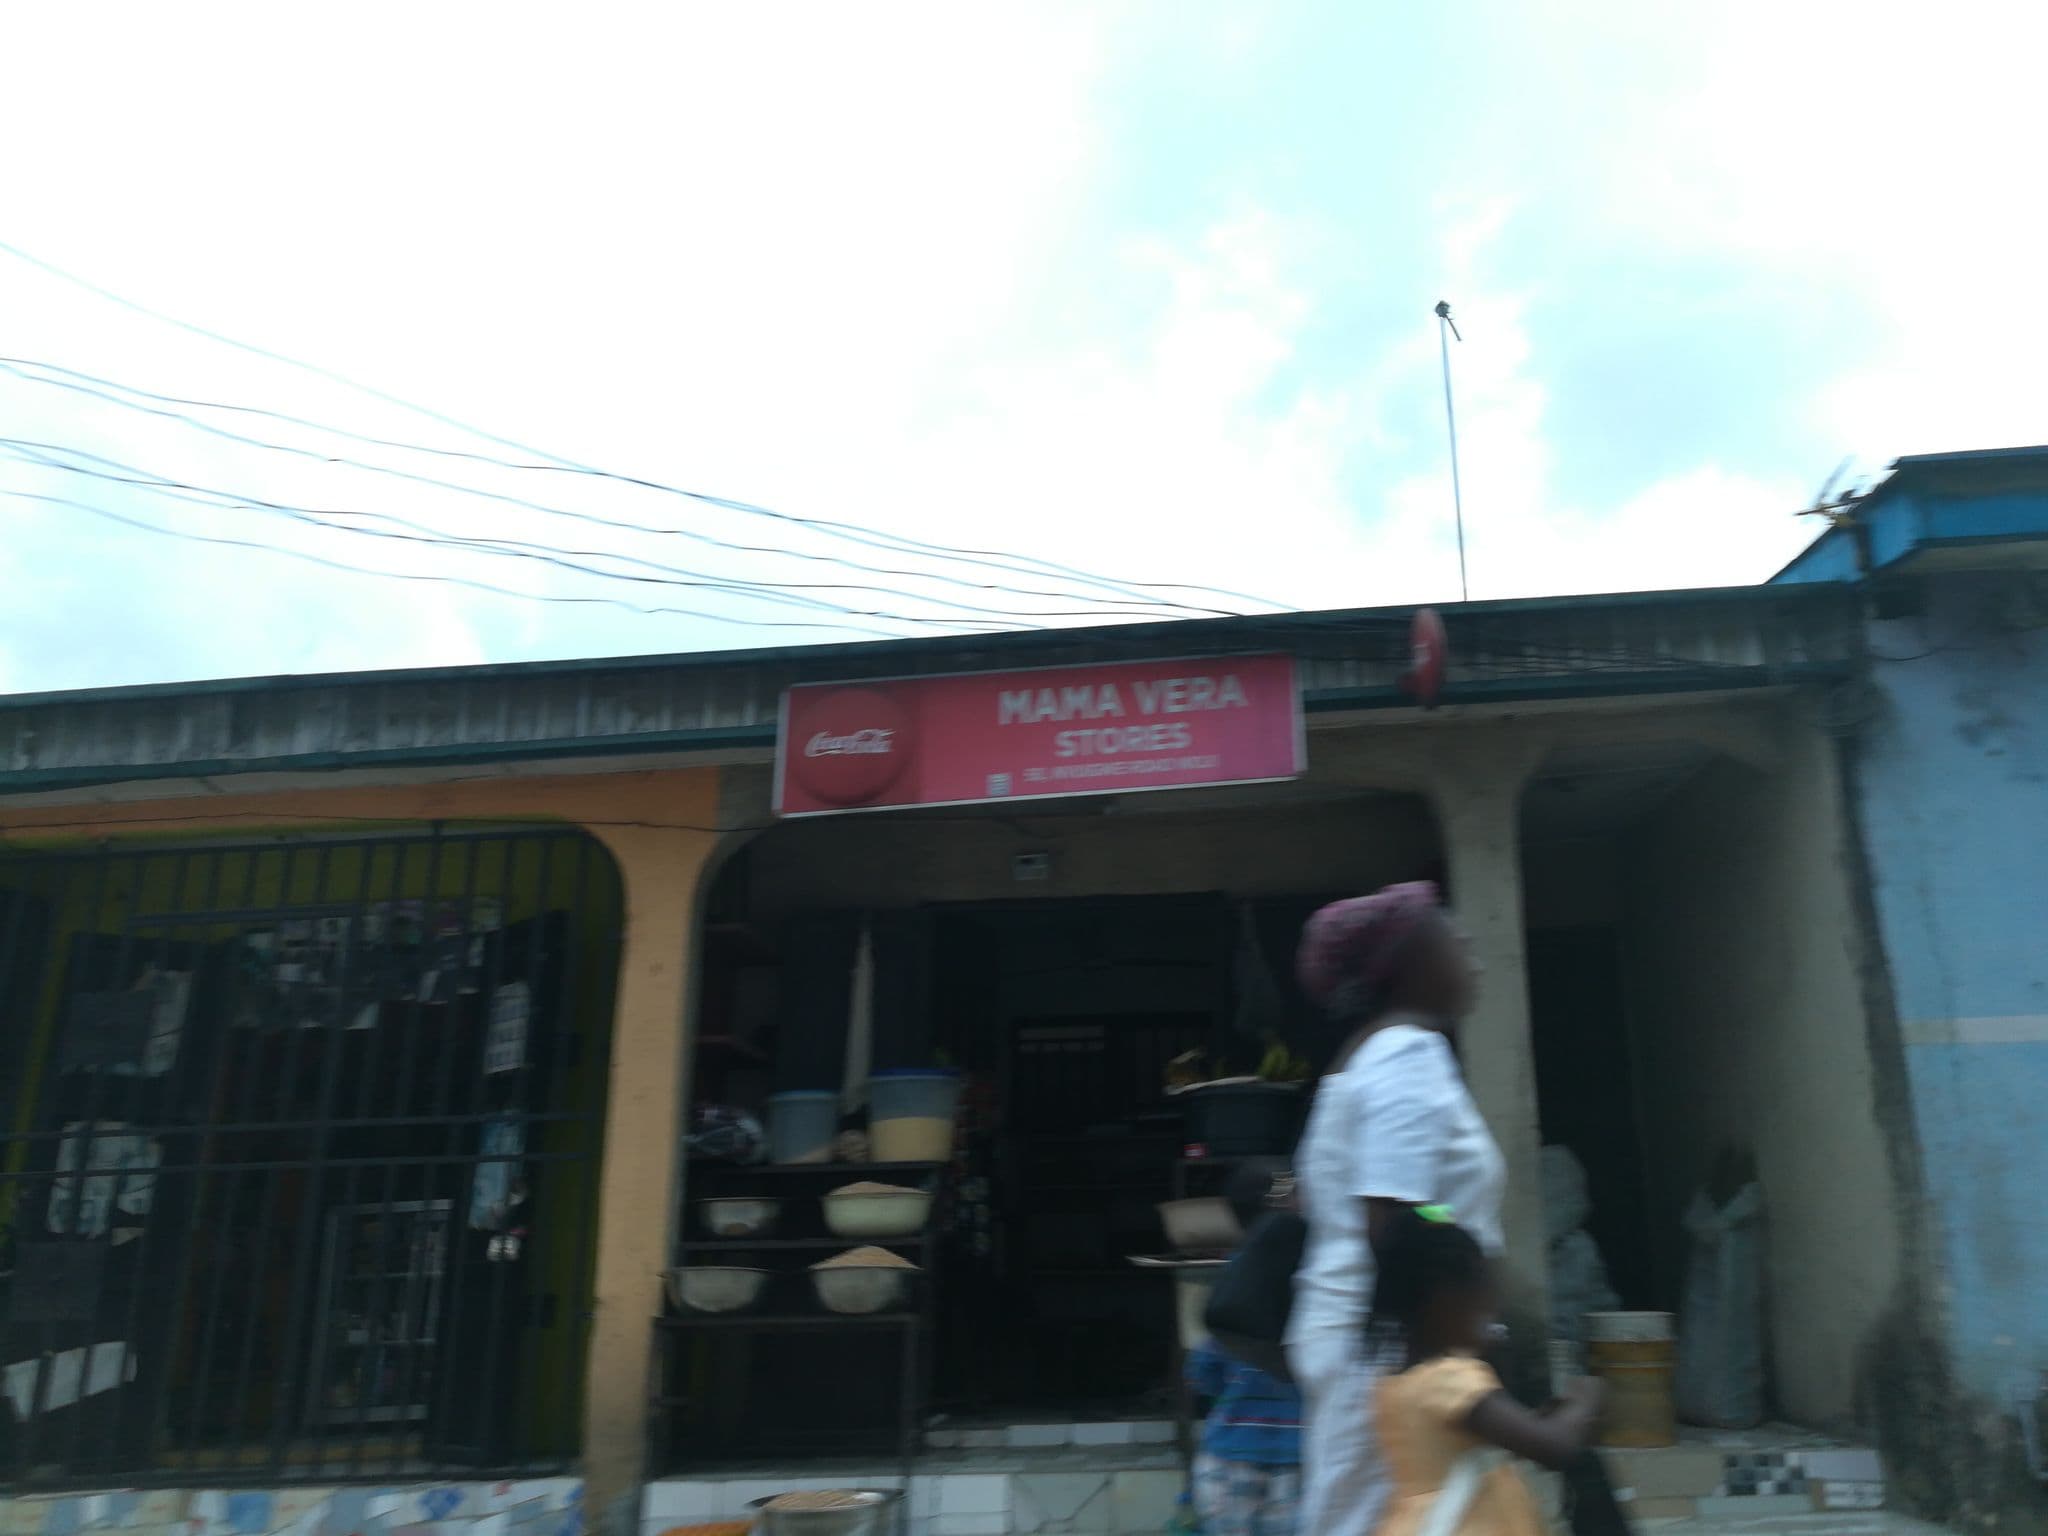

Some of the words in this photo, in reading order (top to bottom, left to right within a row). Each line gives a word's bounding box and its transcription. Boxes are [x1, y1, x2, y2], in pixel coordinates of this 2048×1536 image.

[998, 683, 1126, 725] MAMA
[1130, 674, 1249, 716] VERA
[1054, 721, 1193, 758] STORES
